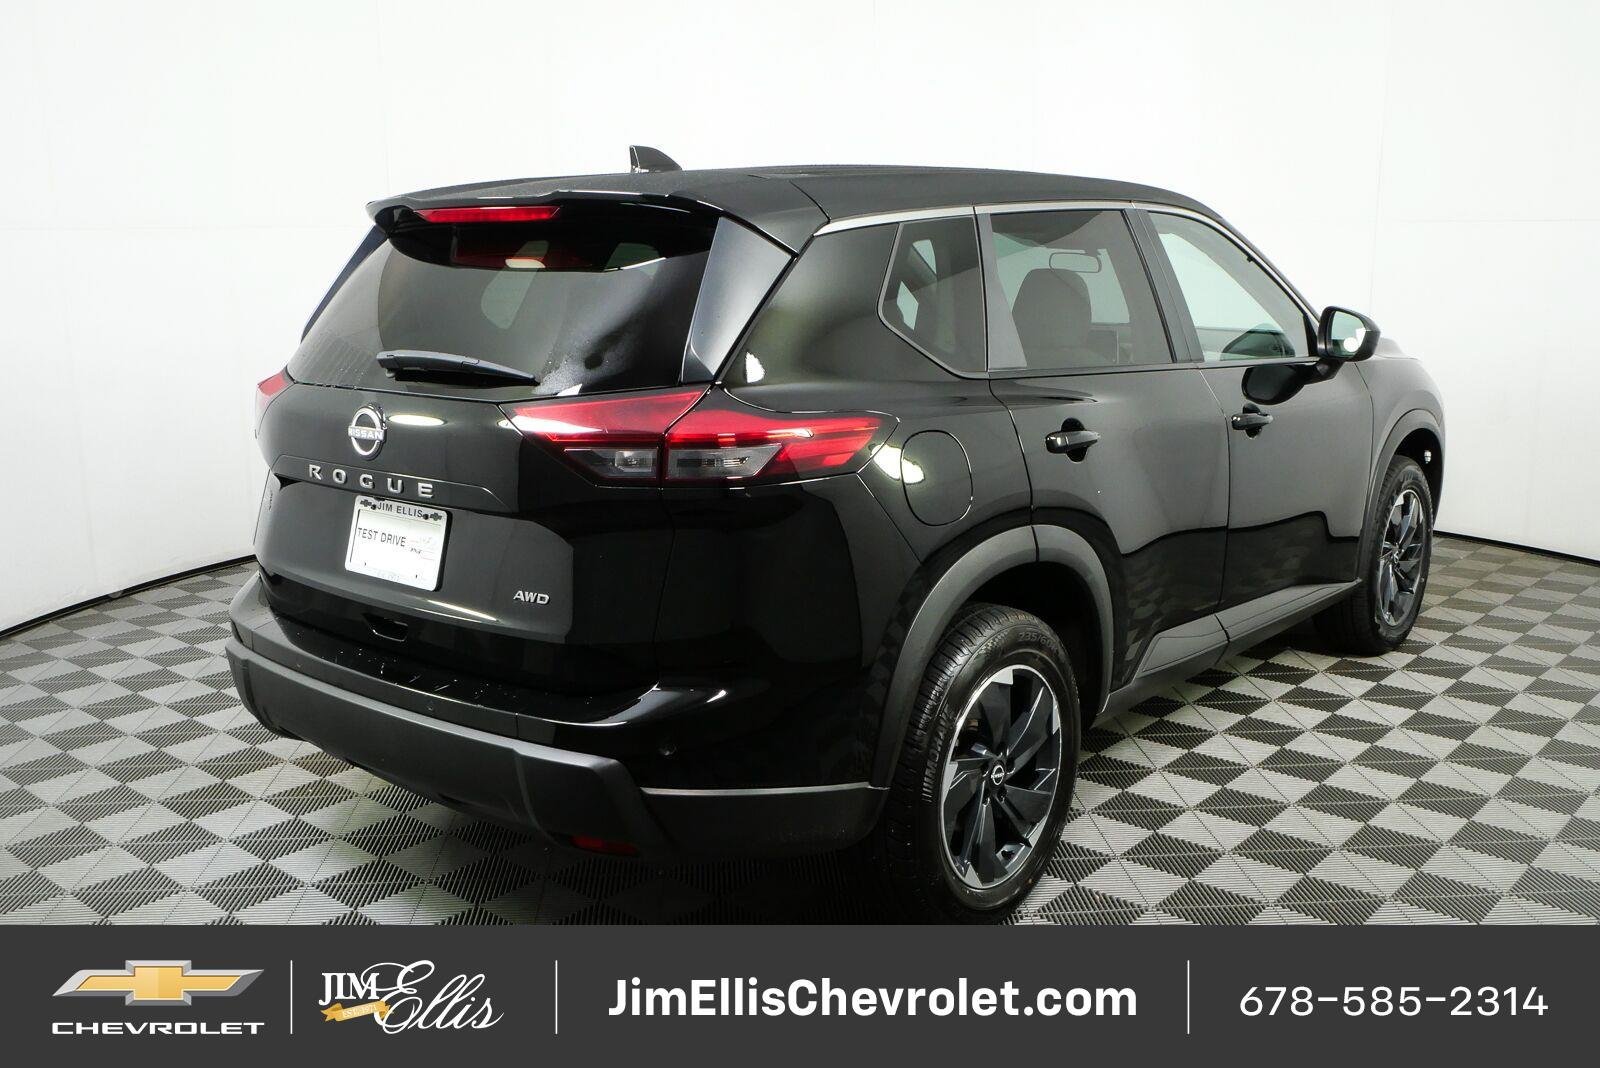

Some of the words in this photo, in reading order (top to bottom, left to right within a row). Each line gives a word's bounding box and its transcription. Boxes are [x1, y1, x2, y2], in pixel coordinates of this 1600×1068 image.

[348, 427, 384, 440] NISSAN
[308, 464, 434, 499] ROGUE
[377, 501, 393, 512] JIM
[396, 506, 423, 518] ELLIS
[357, 527, 379, 541] TEST
[380, 532, 407, 547] DRIVE
[513, 590, 550, 605] AWD
